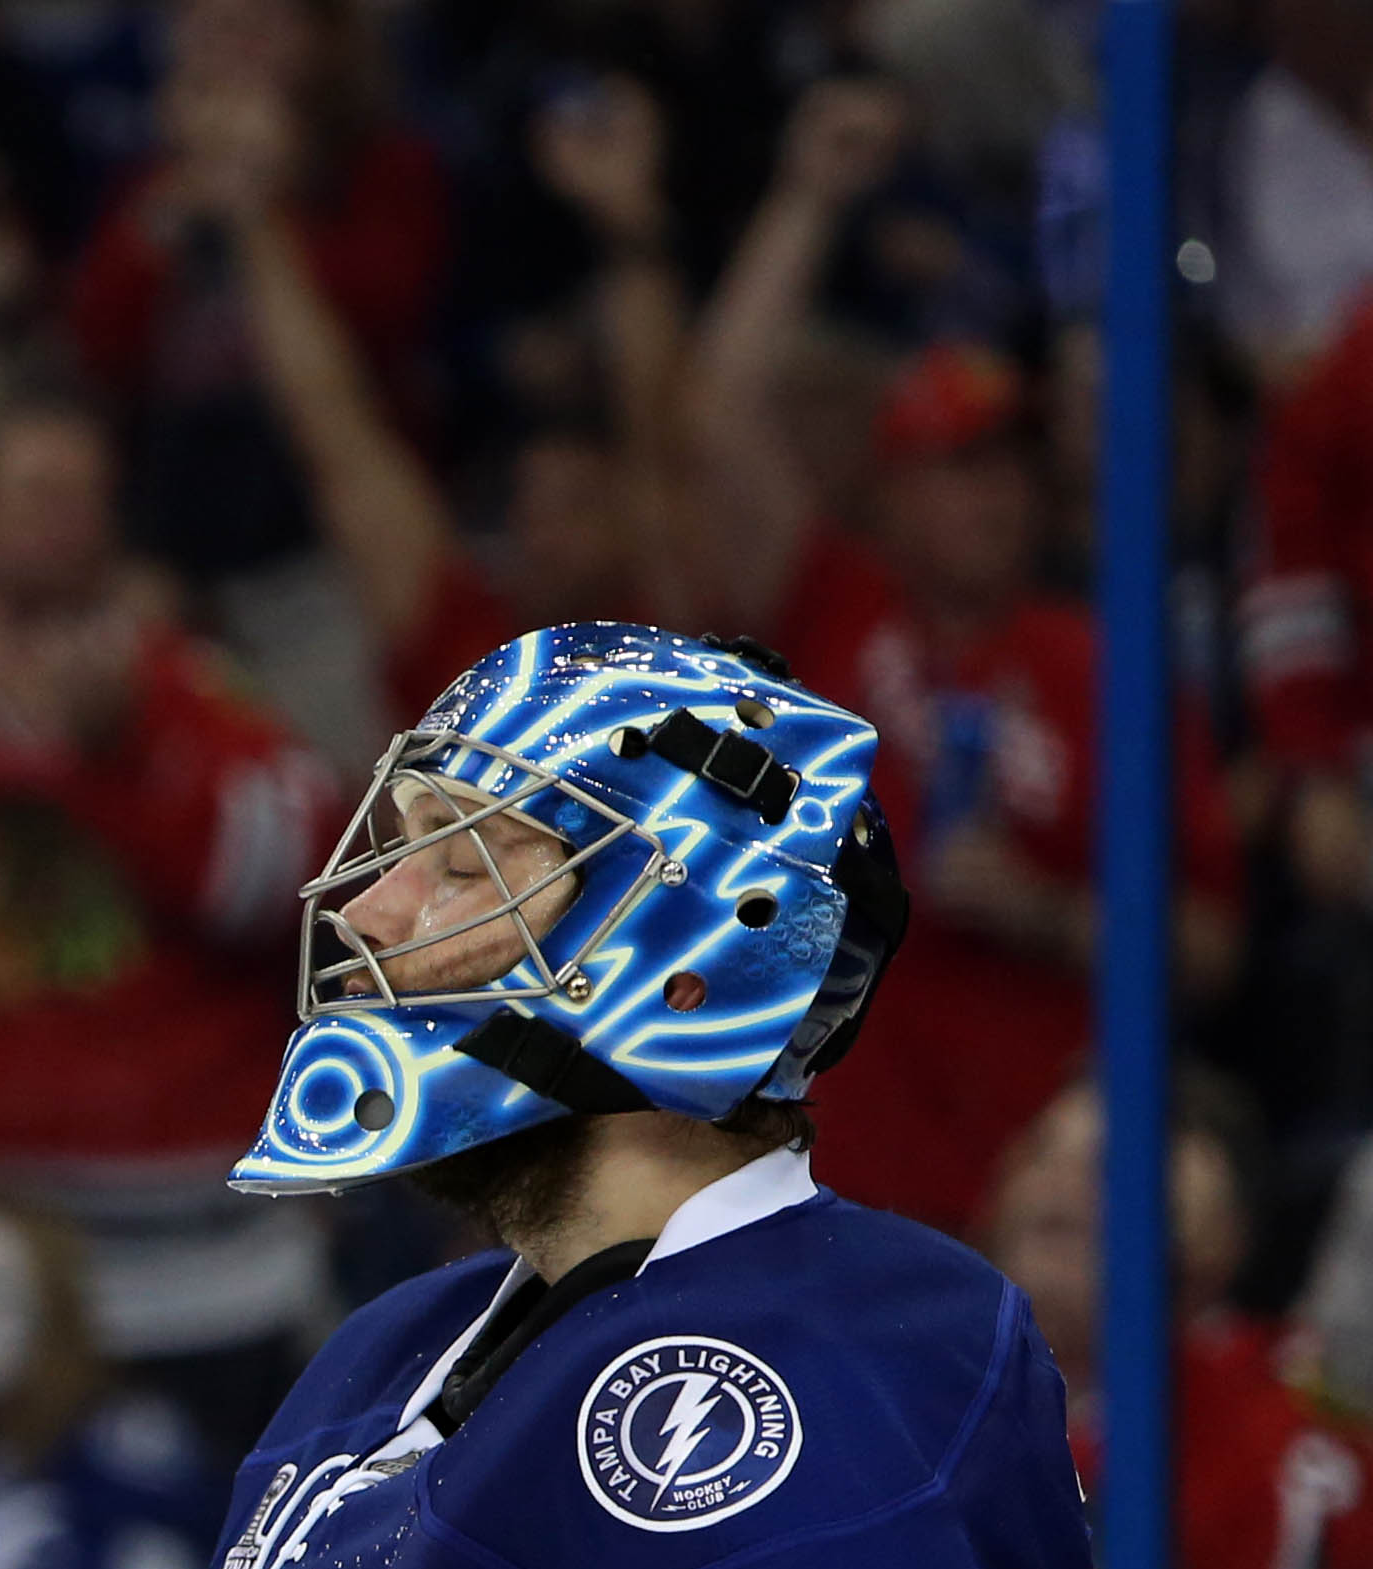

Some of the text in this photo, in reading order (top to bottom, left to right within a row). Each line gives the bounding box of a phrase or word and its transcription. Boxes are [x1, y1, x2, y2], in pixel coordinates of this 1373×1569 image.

[592, 1349, 785, 1502] TAMPA BAY LIGHTNING
[673, 1475, 732, 1502] HOCKEY
[686, 1493, 725, 1511] CLUB
